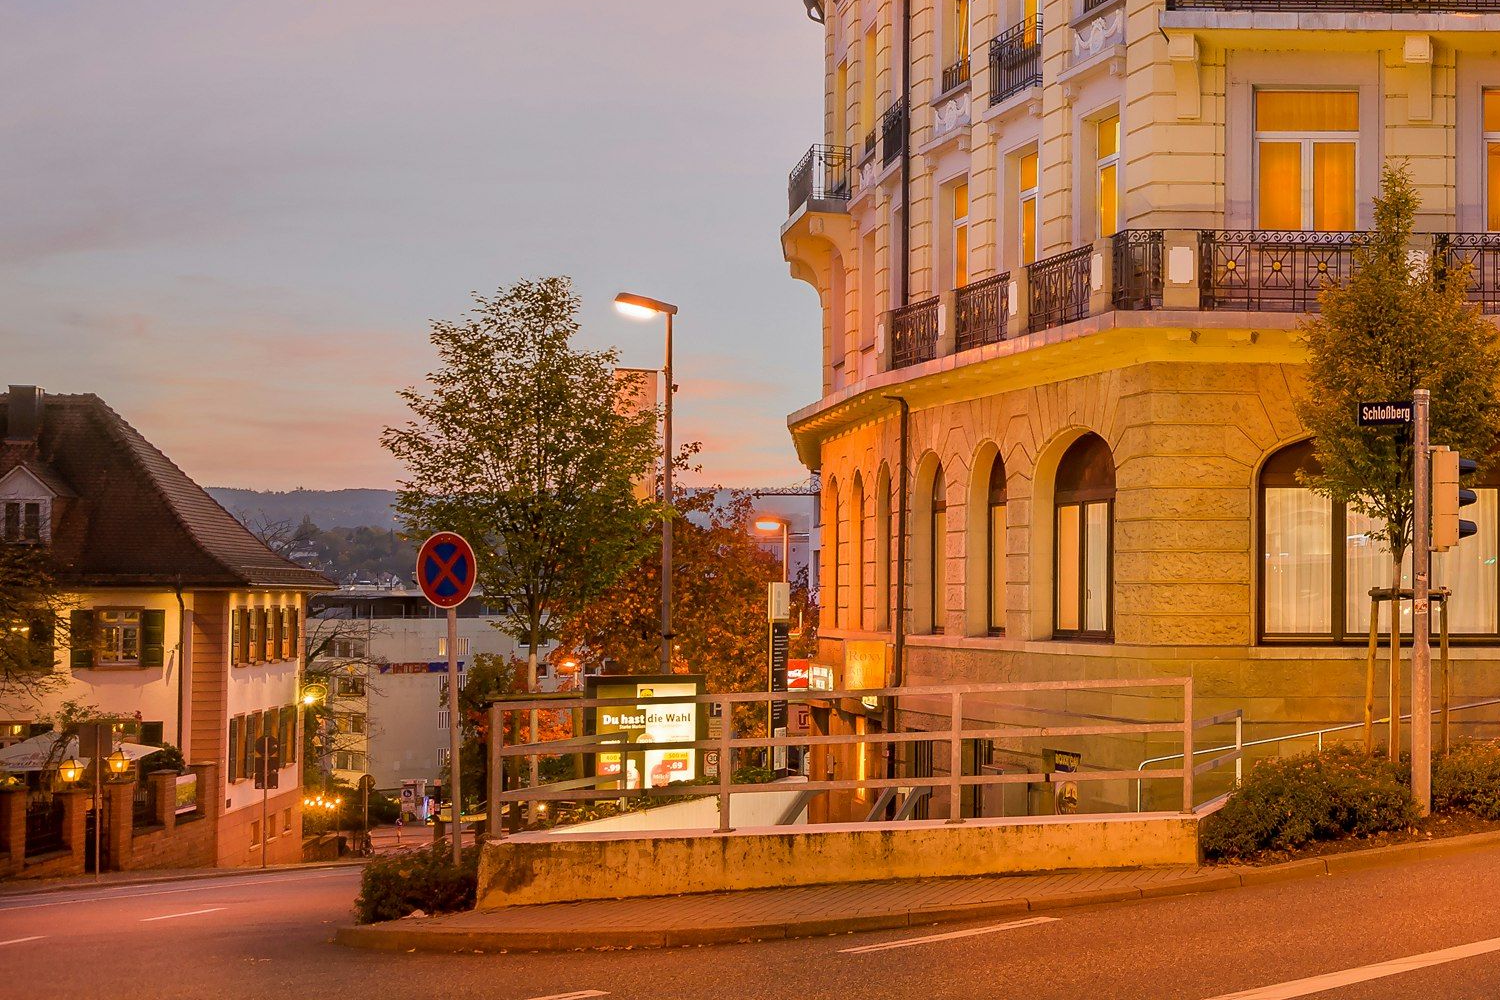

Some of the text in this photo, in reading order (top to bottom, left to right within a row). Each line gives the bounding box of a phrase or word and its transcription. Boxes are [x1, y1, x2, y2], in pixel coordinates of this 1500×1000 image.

[1362, 405, 1410, 422] Schloßberg
[392, 661, 465, 674] INTEROT
[602, 713, 691, 725] Du hast die Wahl
